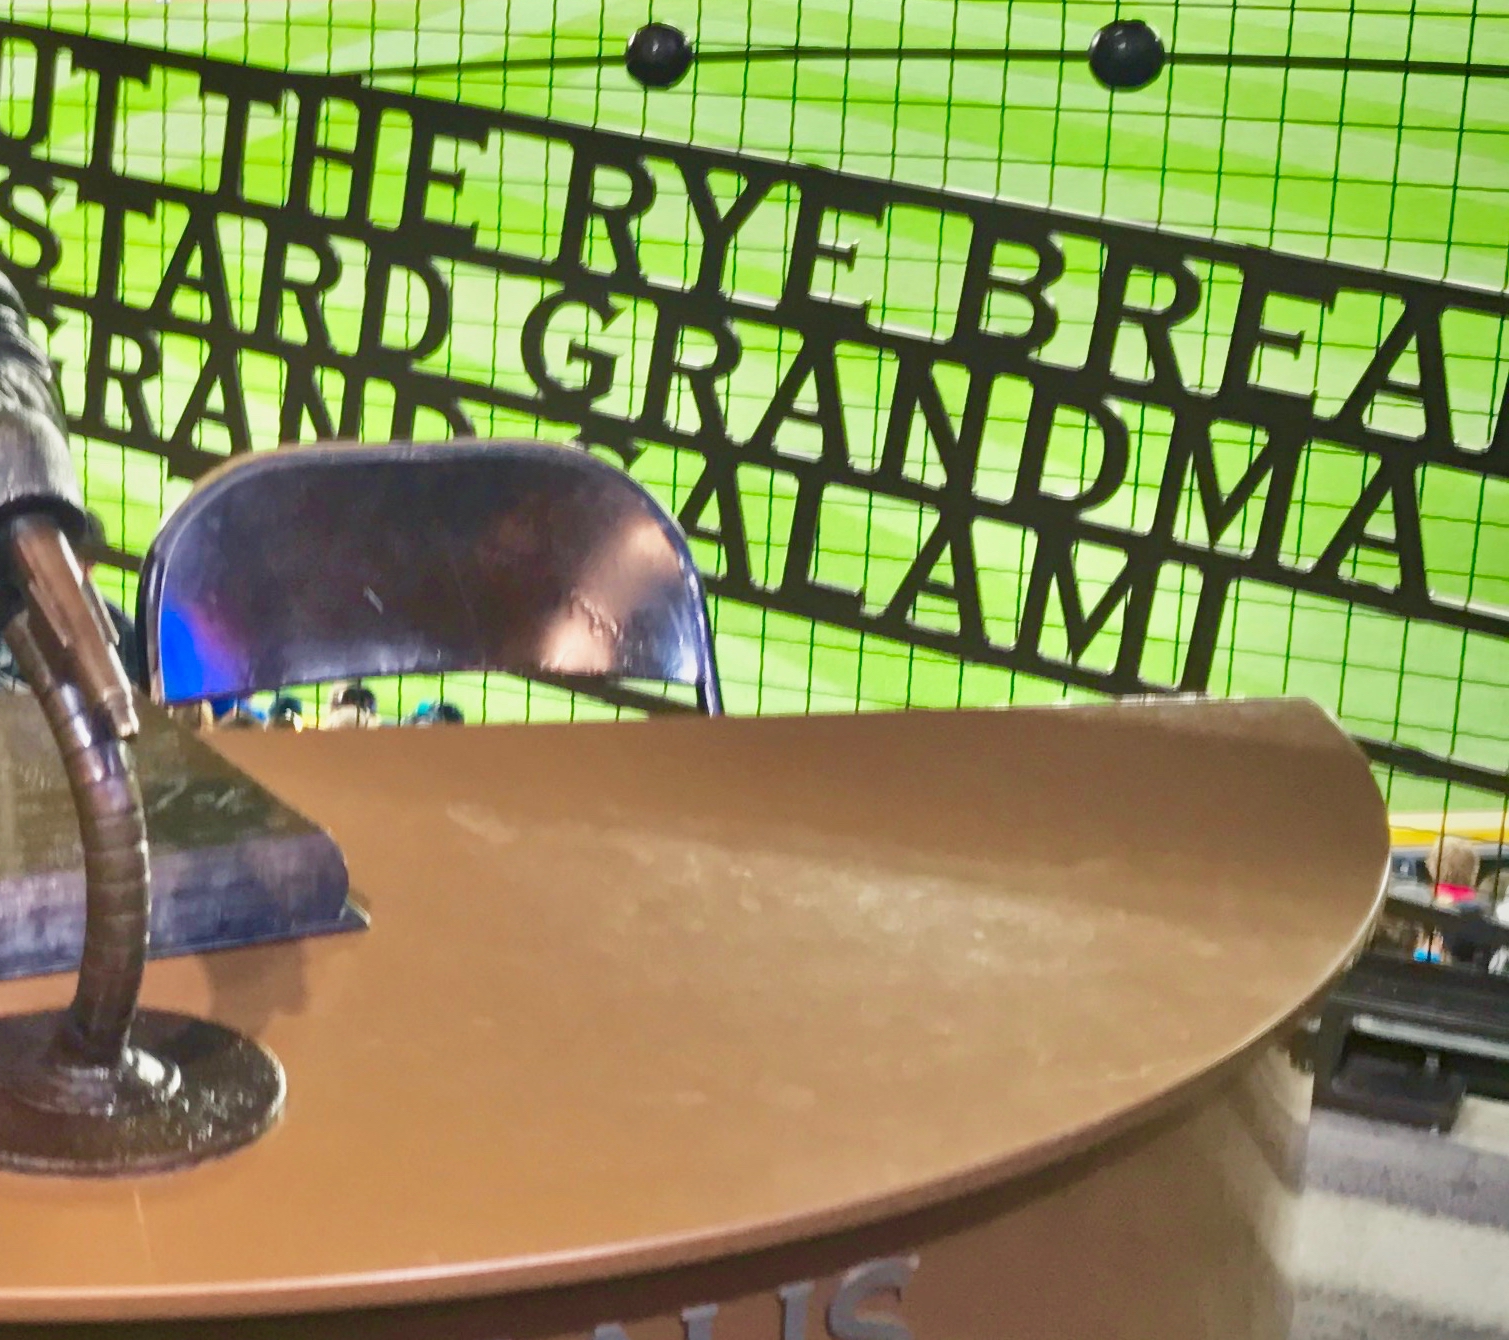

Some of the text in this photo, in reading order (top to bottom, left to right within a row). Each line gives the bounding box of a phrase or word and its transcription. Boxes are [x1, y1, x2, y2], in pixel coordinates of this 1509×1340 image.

[200, 68, 490, 254] THE
[556, 128, 886, 328] RYE
[520, 286, 1438, 602] GRANDMA
